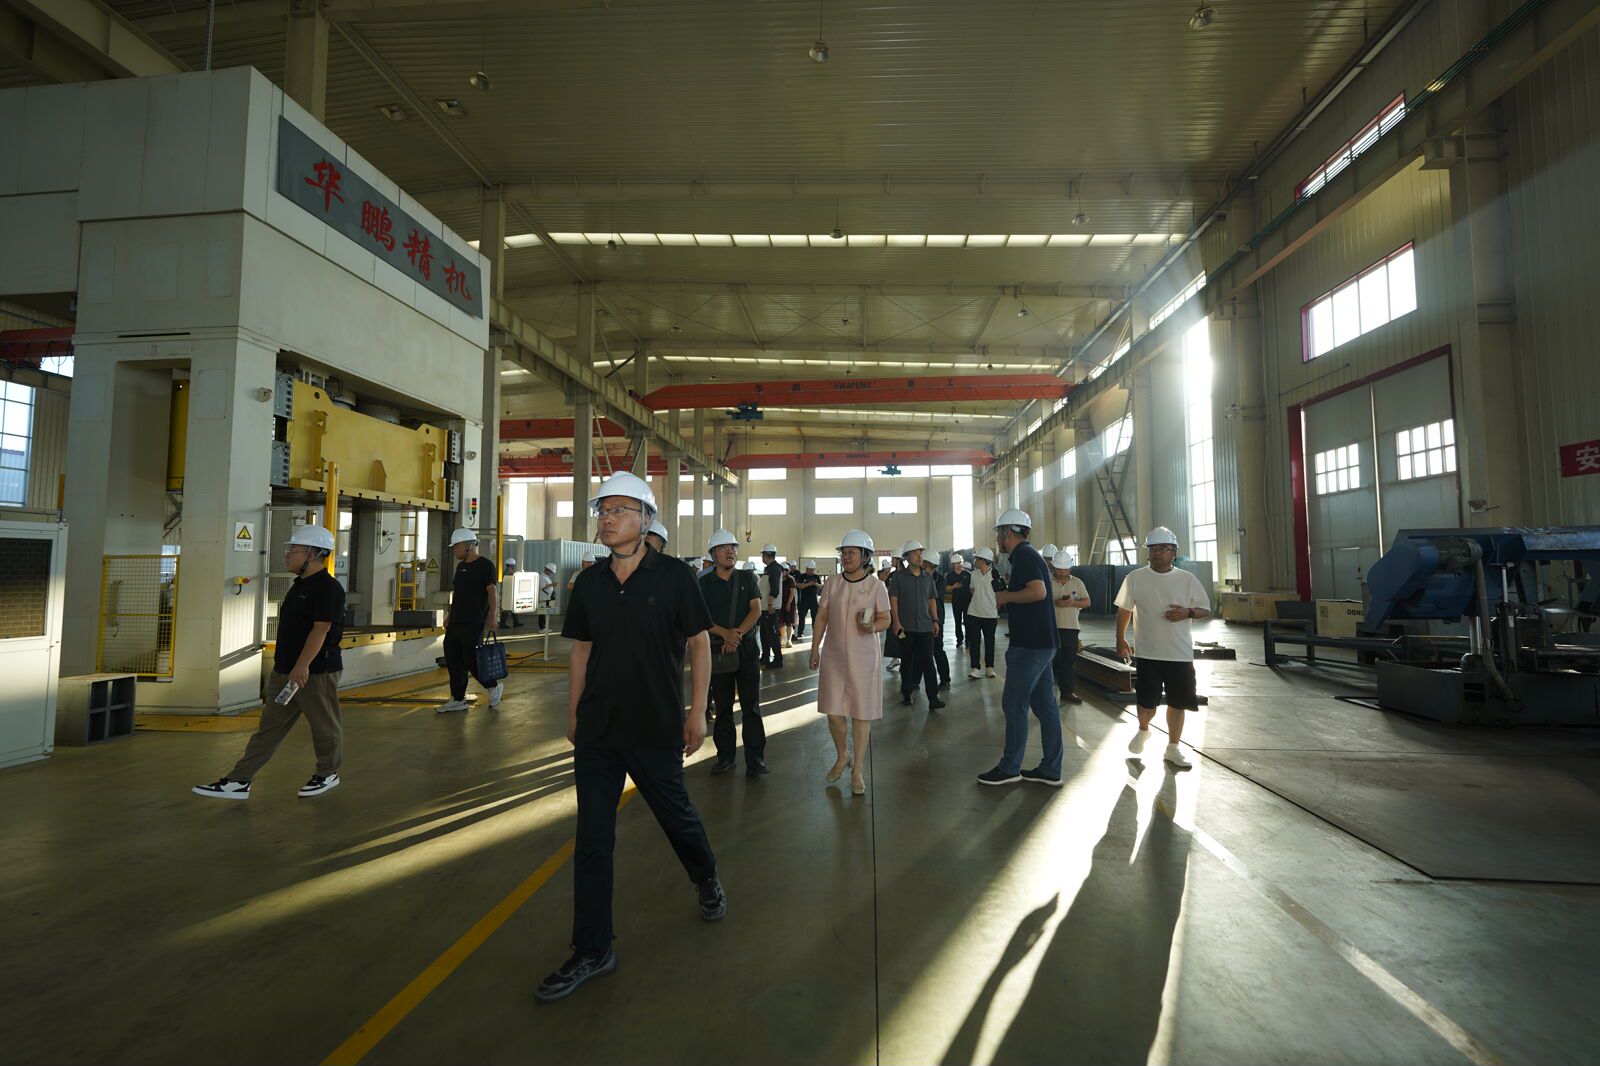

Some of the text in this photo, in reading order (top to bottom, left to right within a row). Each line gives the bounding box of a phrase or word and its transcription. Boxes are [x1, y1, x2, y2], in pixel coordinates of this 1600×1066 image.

[304, 157, 473, 302] 华鹏精机
[1576, 445, 1600, 471] 安
